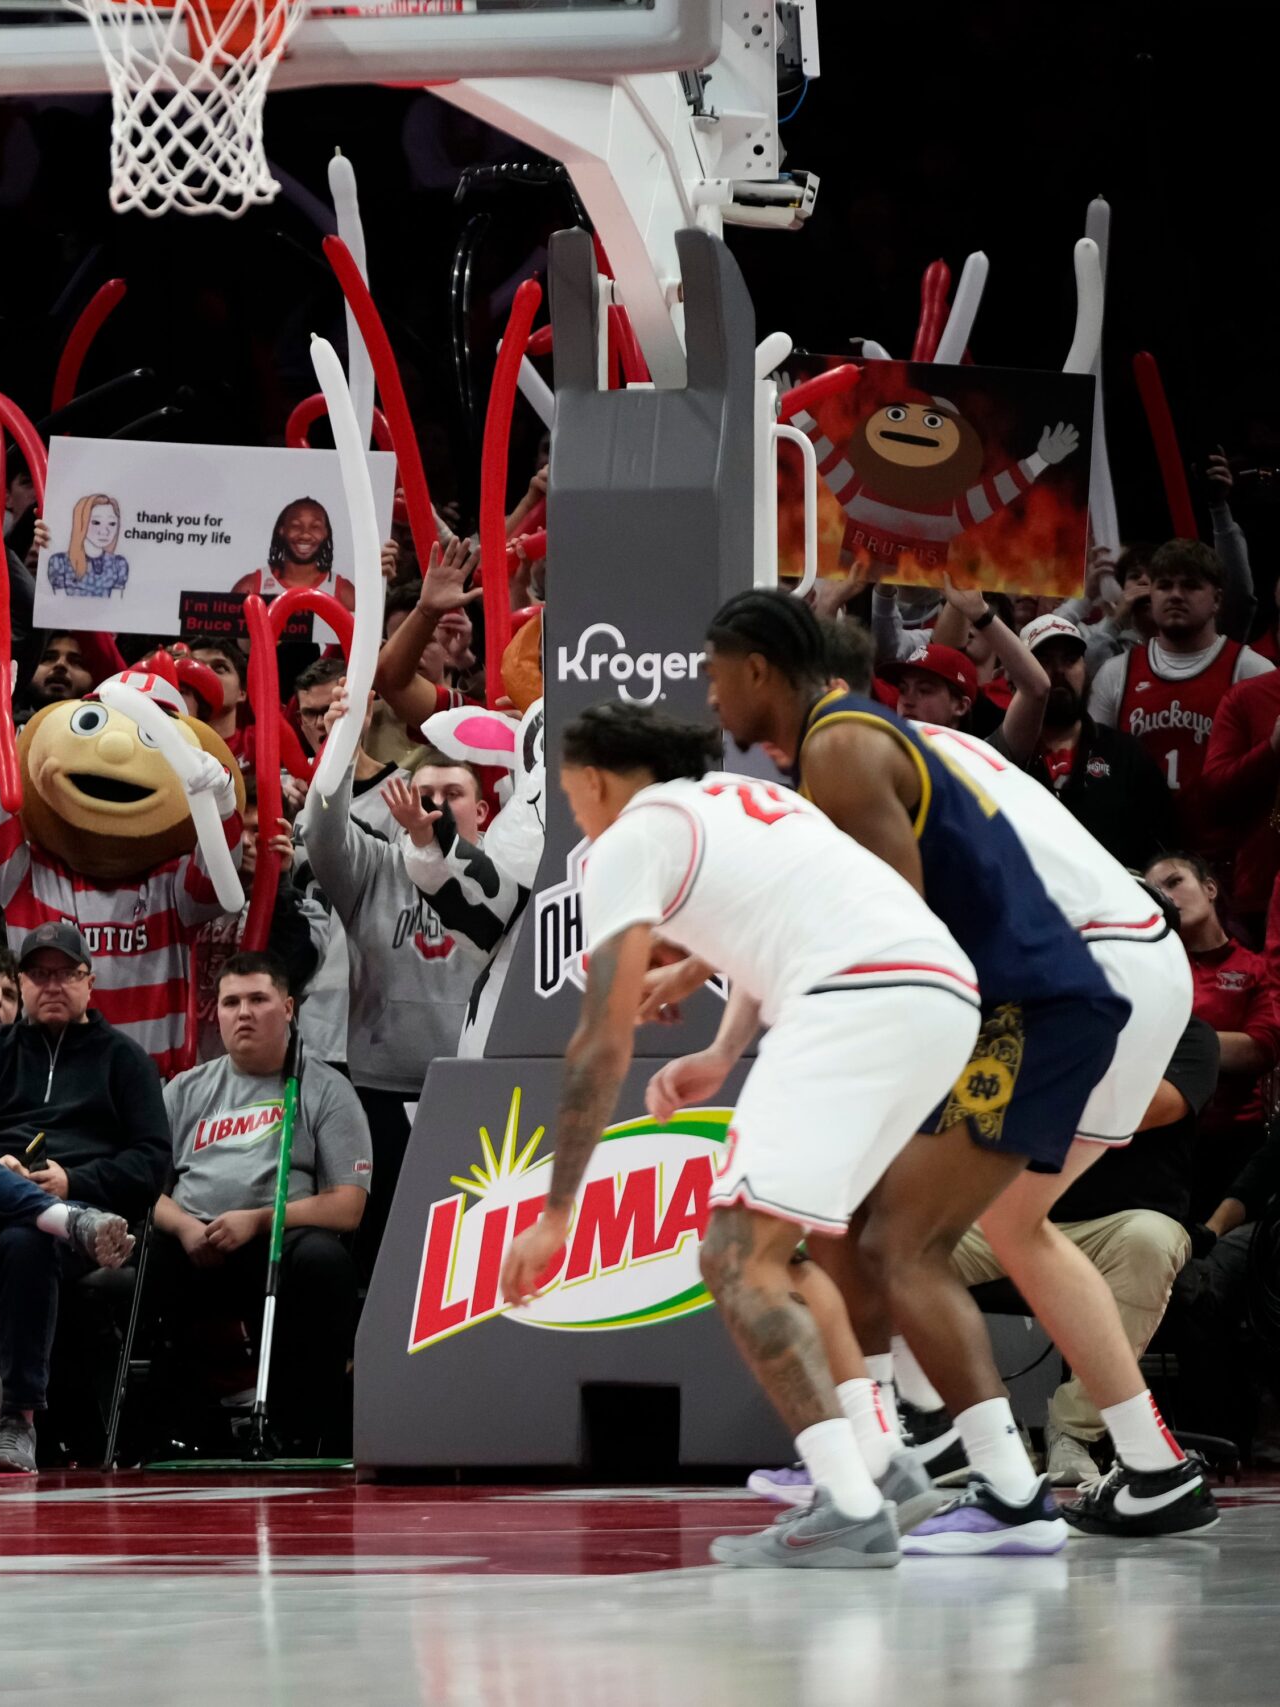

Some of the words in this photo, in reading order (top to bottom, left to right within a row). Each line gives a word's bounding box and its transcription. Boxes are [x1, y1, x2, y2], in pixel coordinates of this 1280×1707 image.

[124, 527, 184, 544] changing
[188, 532, 208, 545] my
[211, 531, 231, 544] life
[137, 510, 173, 524] thank
[177, 515, 201, 528] you
[204, 514, 223, 526] for
[184, 600, 209, 613] I'm
[186, 617, 232, 631] Bruce
[558, 622, 707, 708] Kroger
[1129, 700, 1213, 744] Buckeye
[1165, 749, 1181, 790] 1
[61, 917, 148, 952] UTUS
[540, 891, 584, 991] OH
[193, 1105, 286, 1151] LIBMAN
